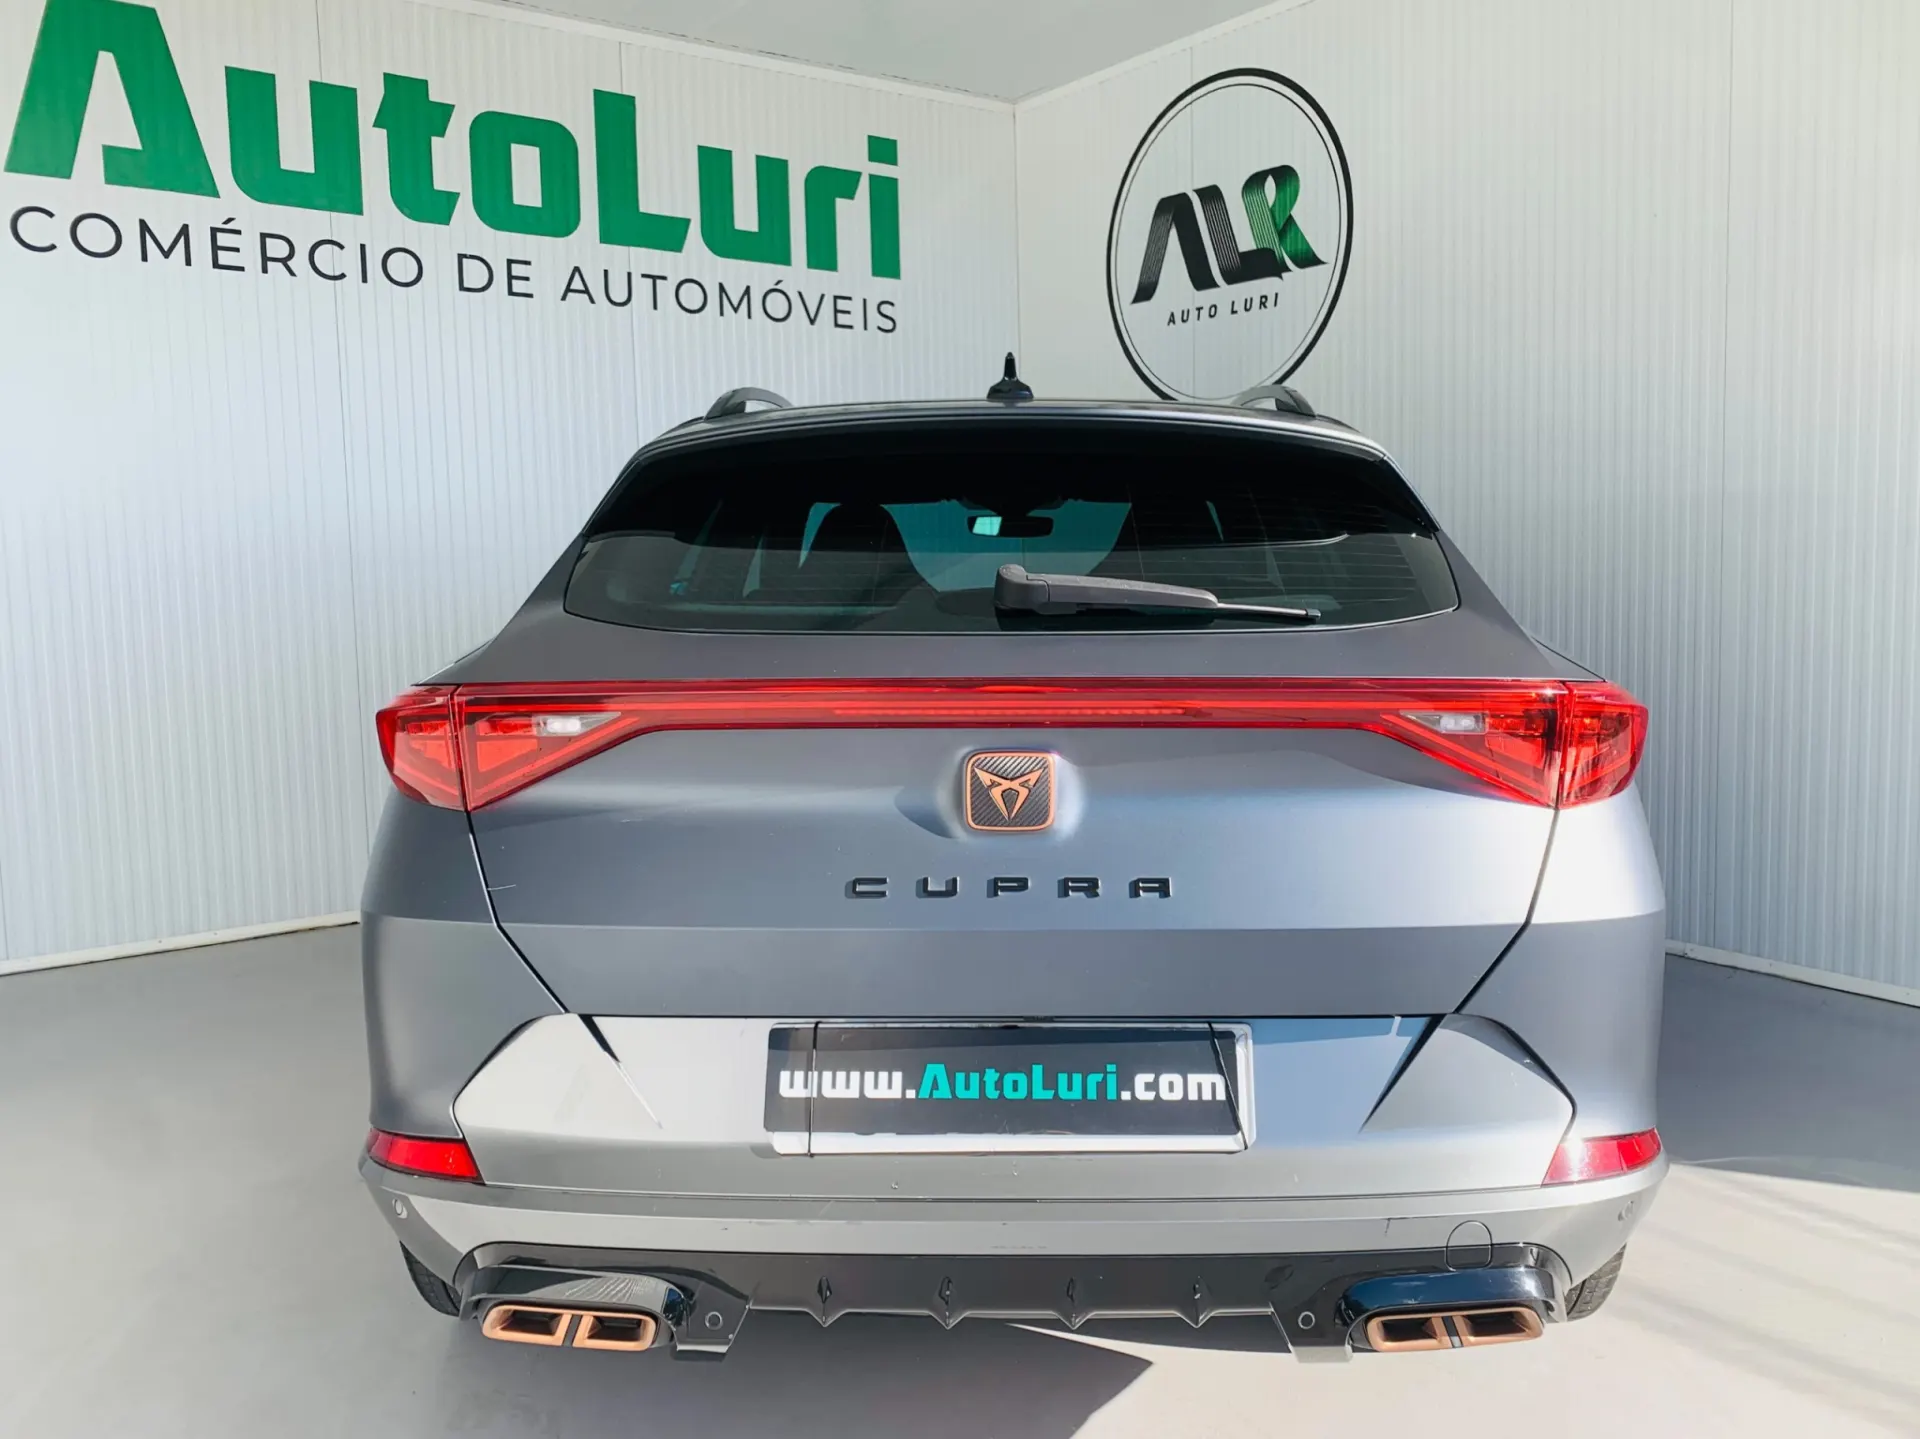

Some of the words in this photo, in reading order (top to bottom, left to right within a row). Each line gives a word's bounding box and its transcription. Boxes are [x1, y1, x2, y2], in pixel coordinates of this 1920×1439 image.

[5, 0, 902, 280] AutoLuri
[9, 205, 425, 288] COMÉRCIO
[458, 254, 535, 299] DE
[561, 266, 899, 334] AUTOMÓVEIS
[1167, 304, 1217, 326] AUTO
[1230, 292, 1280, 315] LURI
[846, 876, 1173, 899] CUPRA
[779, 1063, 1227, 1101] www.AutoLuri.com
